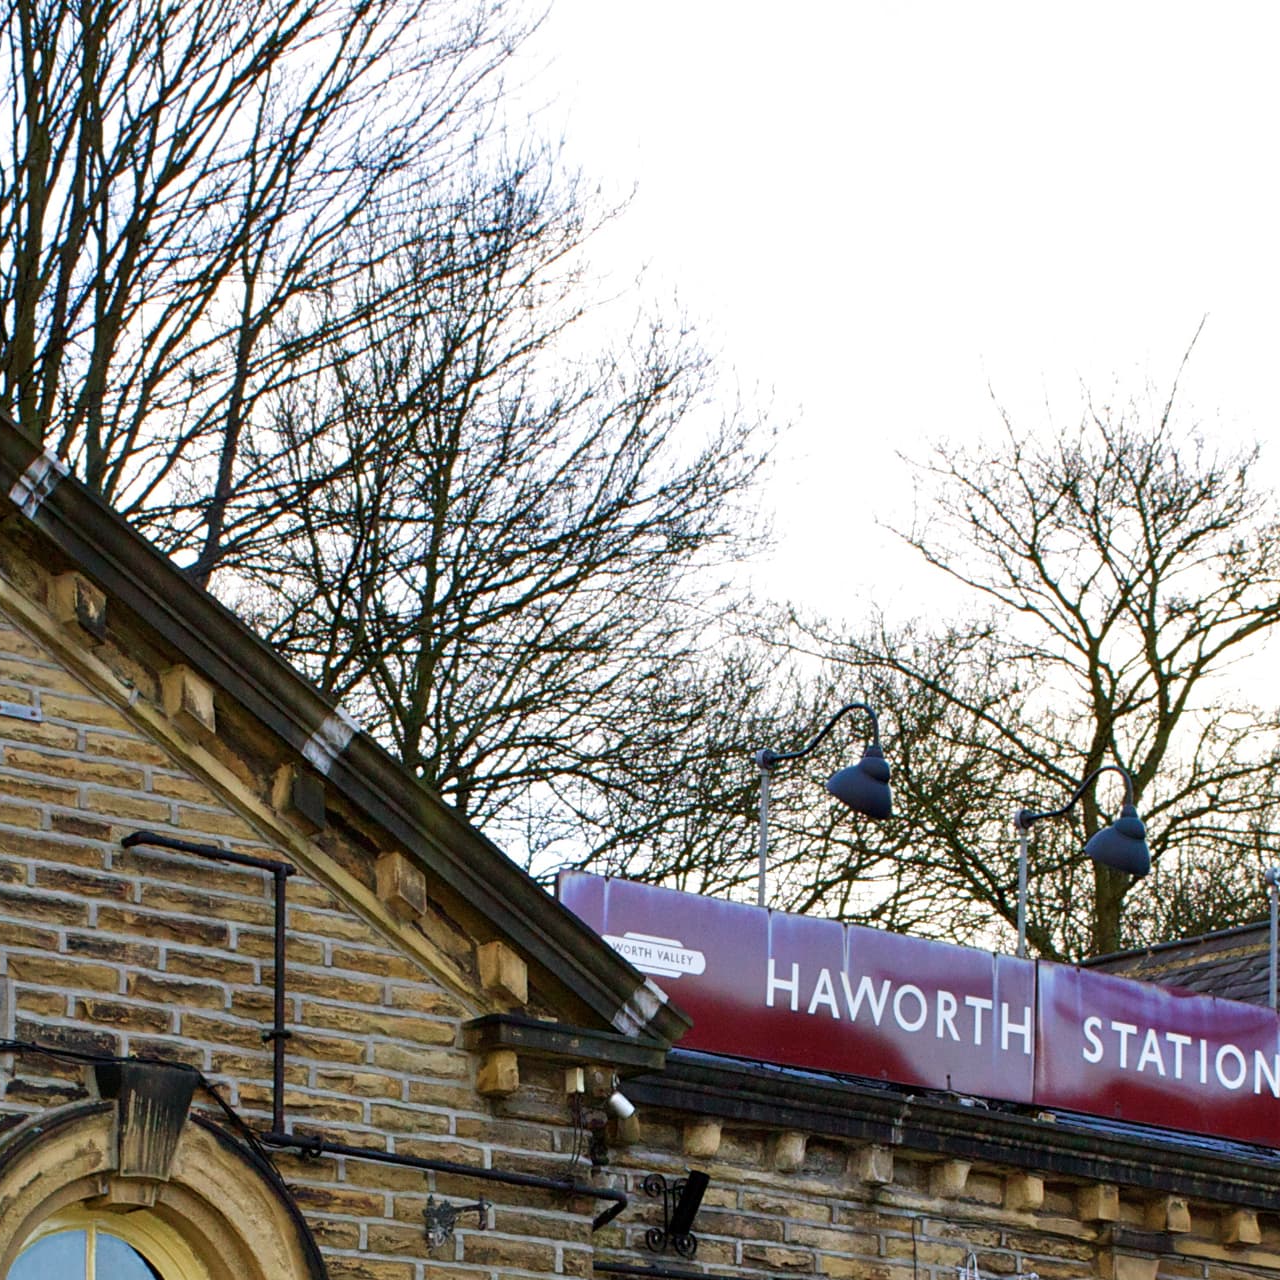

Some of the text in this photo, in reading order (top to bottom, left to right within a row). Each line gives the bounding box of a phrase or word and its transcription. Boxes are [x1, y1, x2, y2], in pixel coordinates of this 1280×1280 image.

[612, 941, 694, 967] WORTH VALLEY
[766, 958, 1280, 1099] HAWORTH STATION
